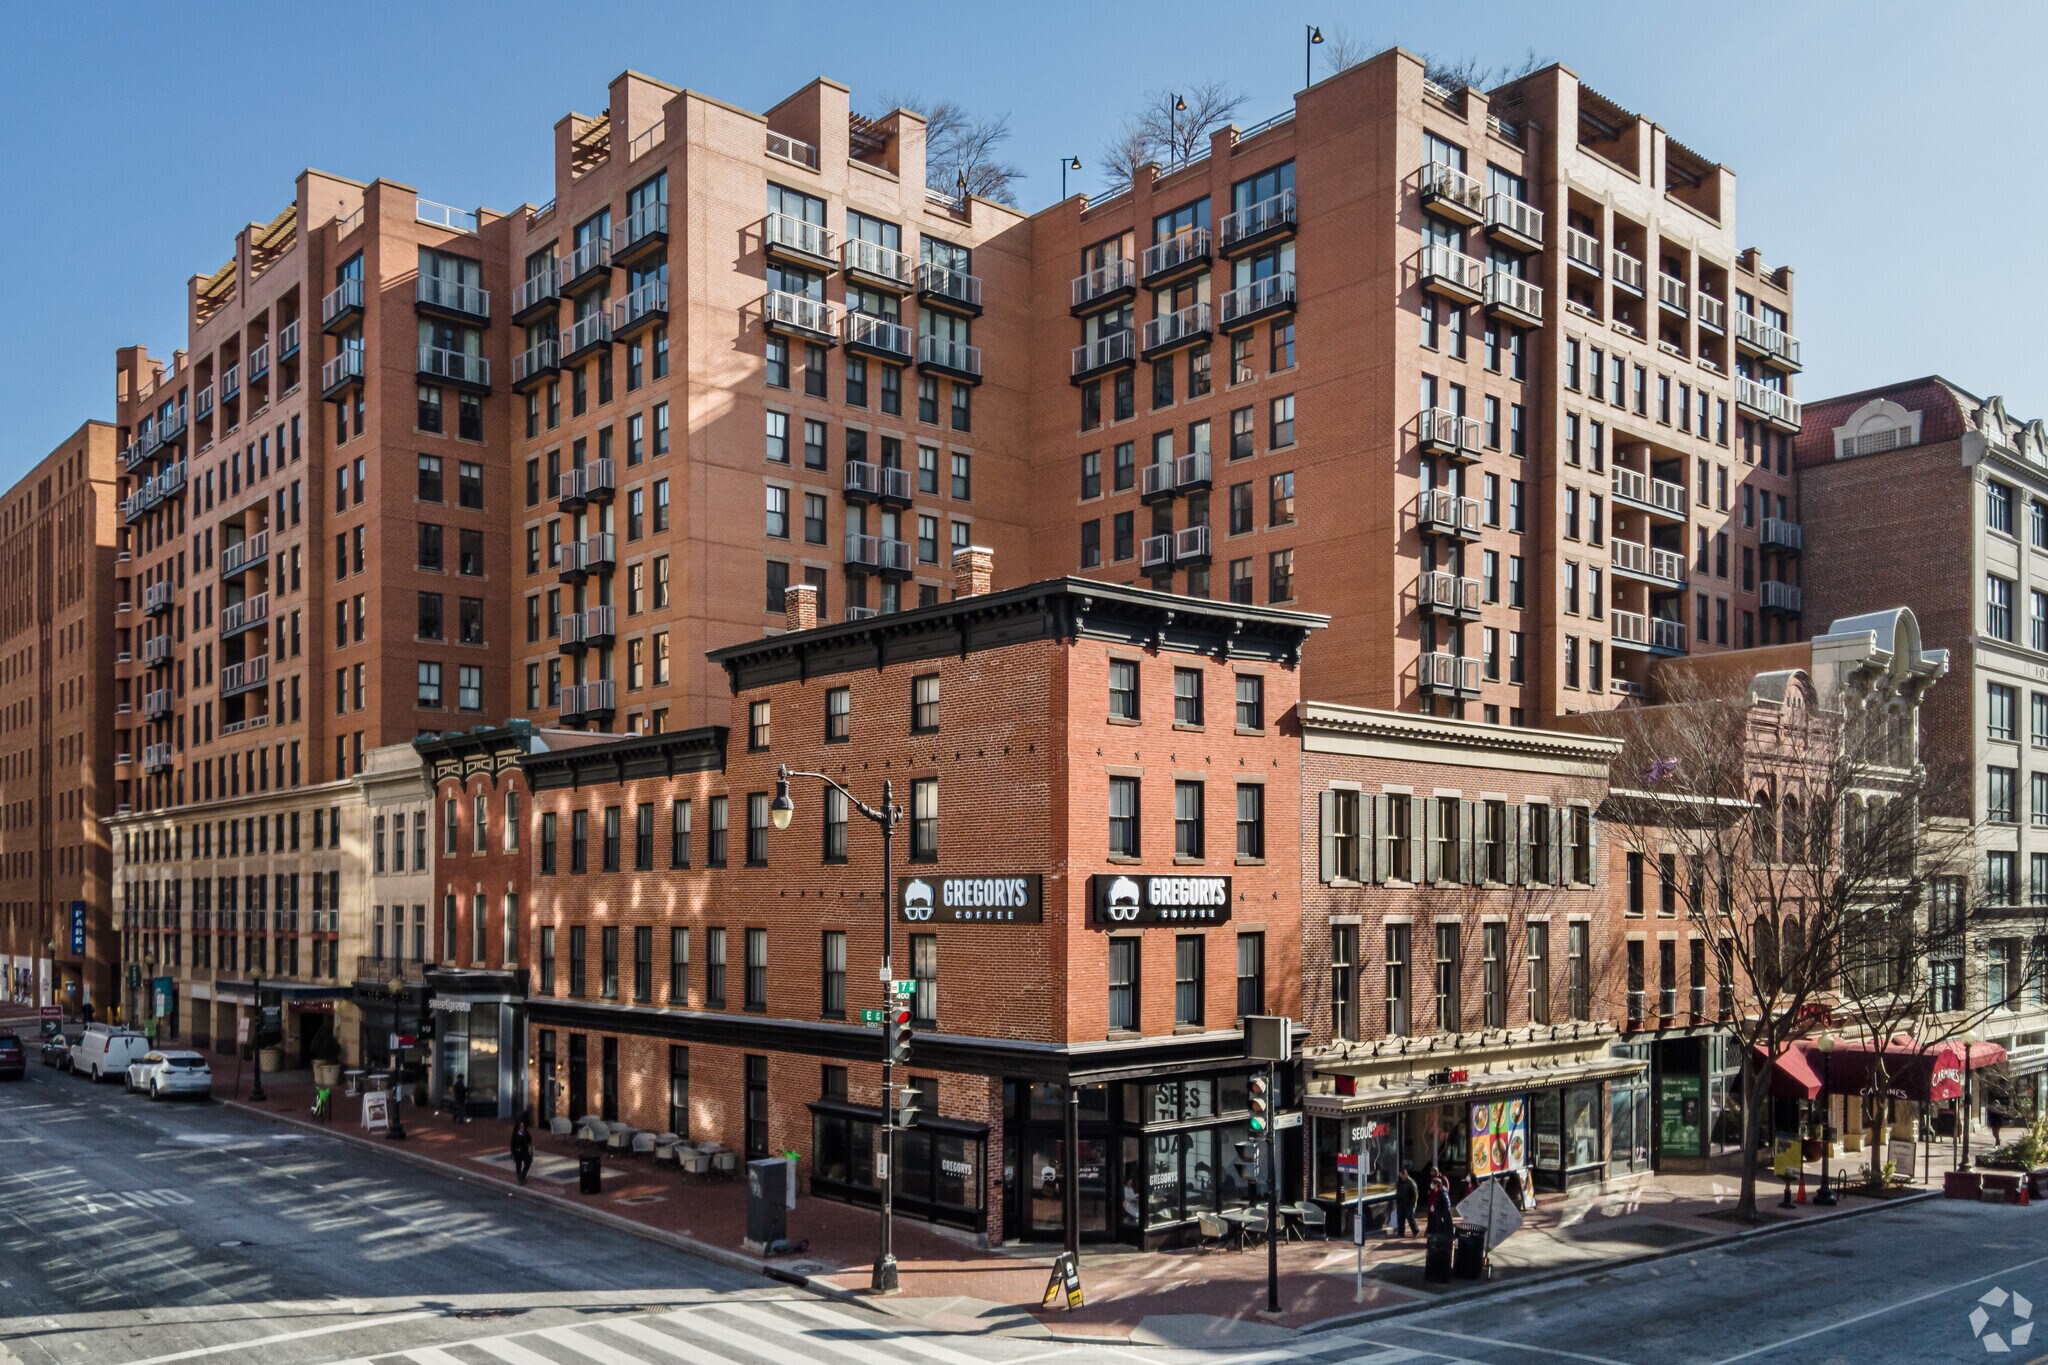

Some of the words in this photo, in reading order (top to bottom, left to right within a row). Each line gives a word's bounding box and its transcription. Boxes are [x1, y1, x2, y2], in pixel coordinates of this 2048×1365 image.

[943, 879, 1028, 907] GREGORYS
[1148, 878, 1226, 906] GREGORYS
[955, 911, 1015, 920] COFFEE
[1161, 909, 1215, 919] COFFEE
[75, 910, 83, 944] PARK
[901, 983, 907, 992] 7
[429, 999, 471, 1012] sweetgreen
[866, 1011, 872, 1021] E
[1859, 1087, 1908, 1100] CAINES
[942, 1160, 972, 1176] GREGORYS
[1150, 1171, 1178, 1186] GREGORYS
